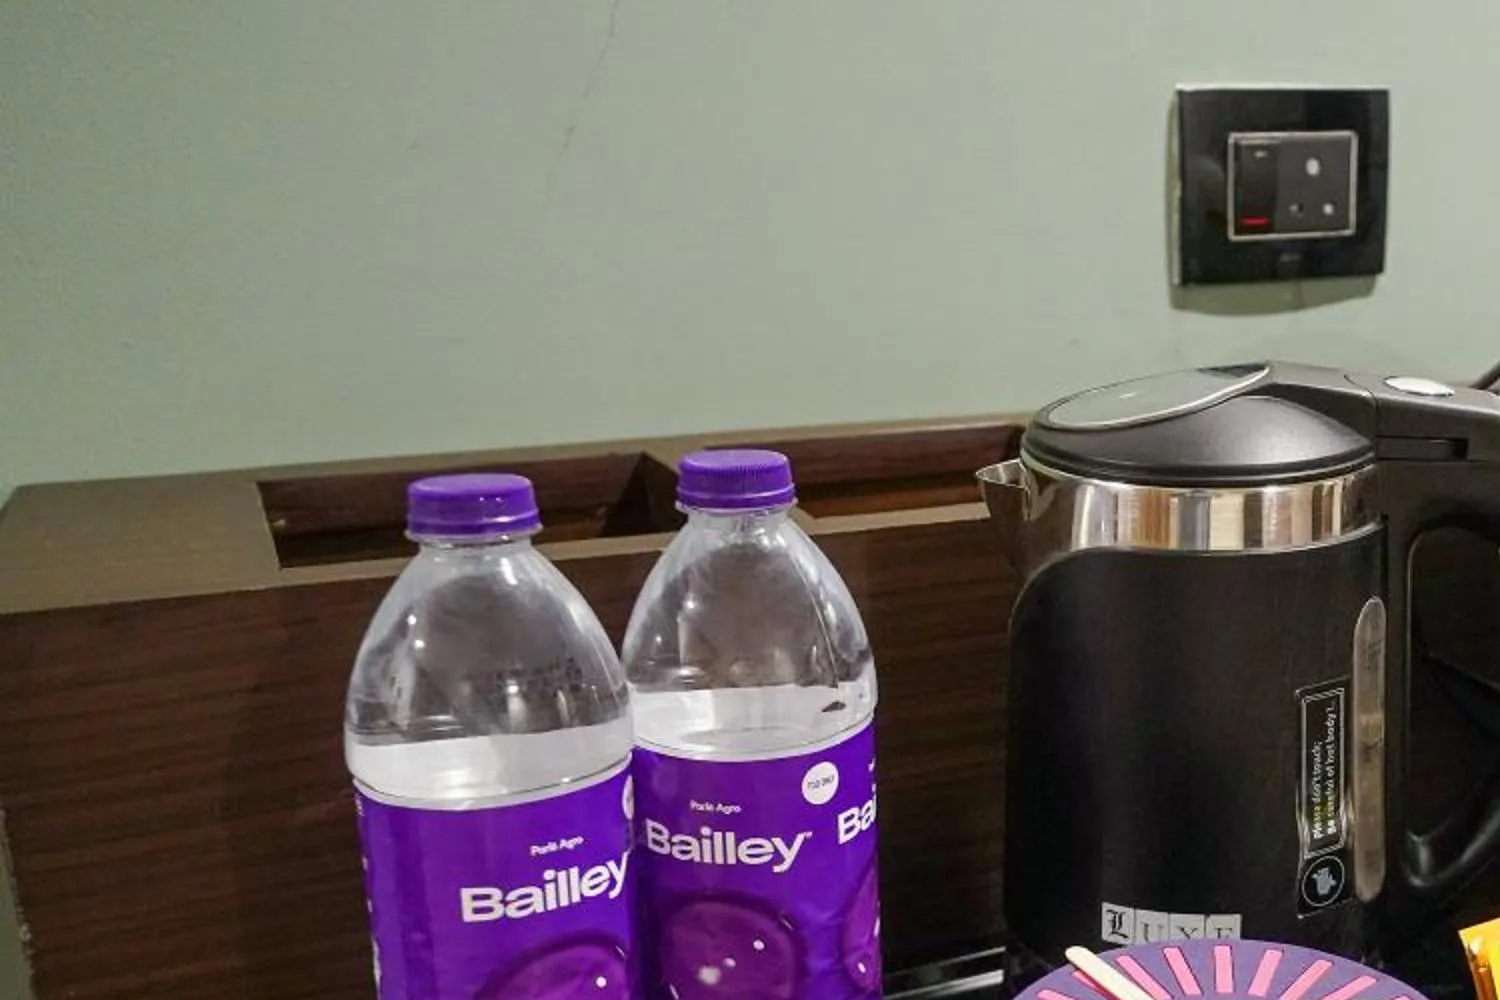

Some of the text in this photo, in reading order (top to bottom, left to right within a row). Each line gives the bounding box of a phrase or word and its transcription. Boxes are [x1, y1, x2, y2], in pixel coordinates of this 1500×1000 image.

[715, 803, 741, 815] Agro
[559, 836, 584, 850] Agro
[645, 818, 806, 873] Bailley
[460, 850, 632, 922] Bailley
